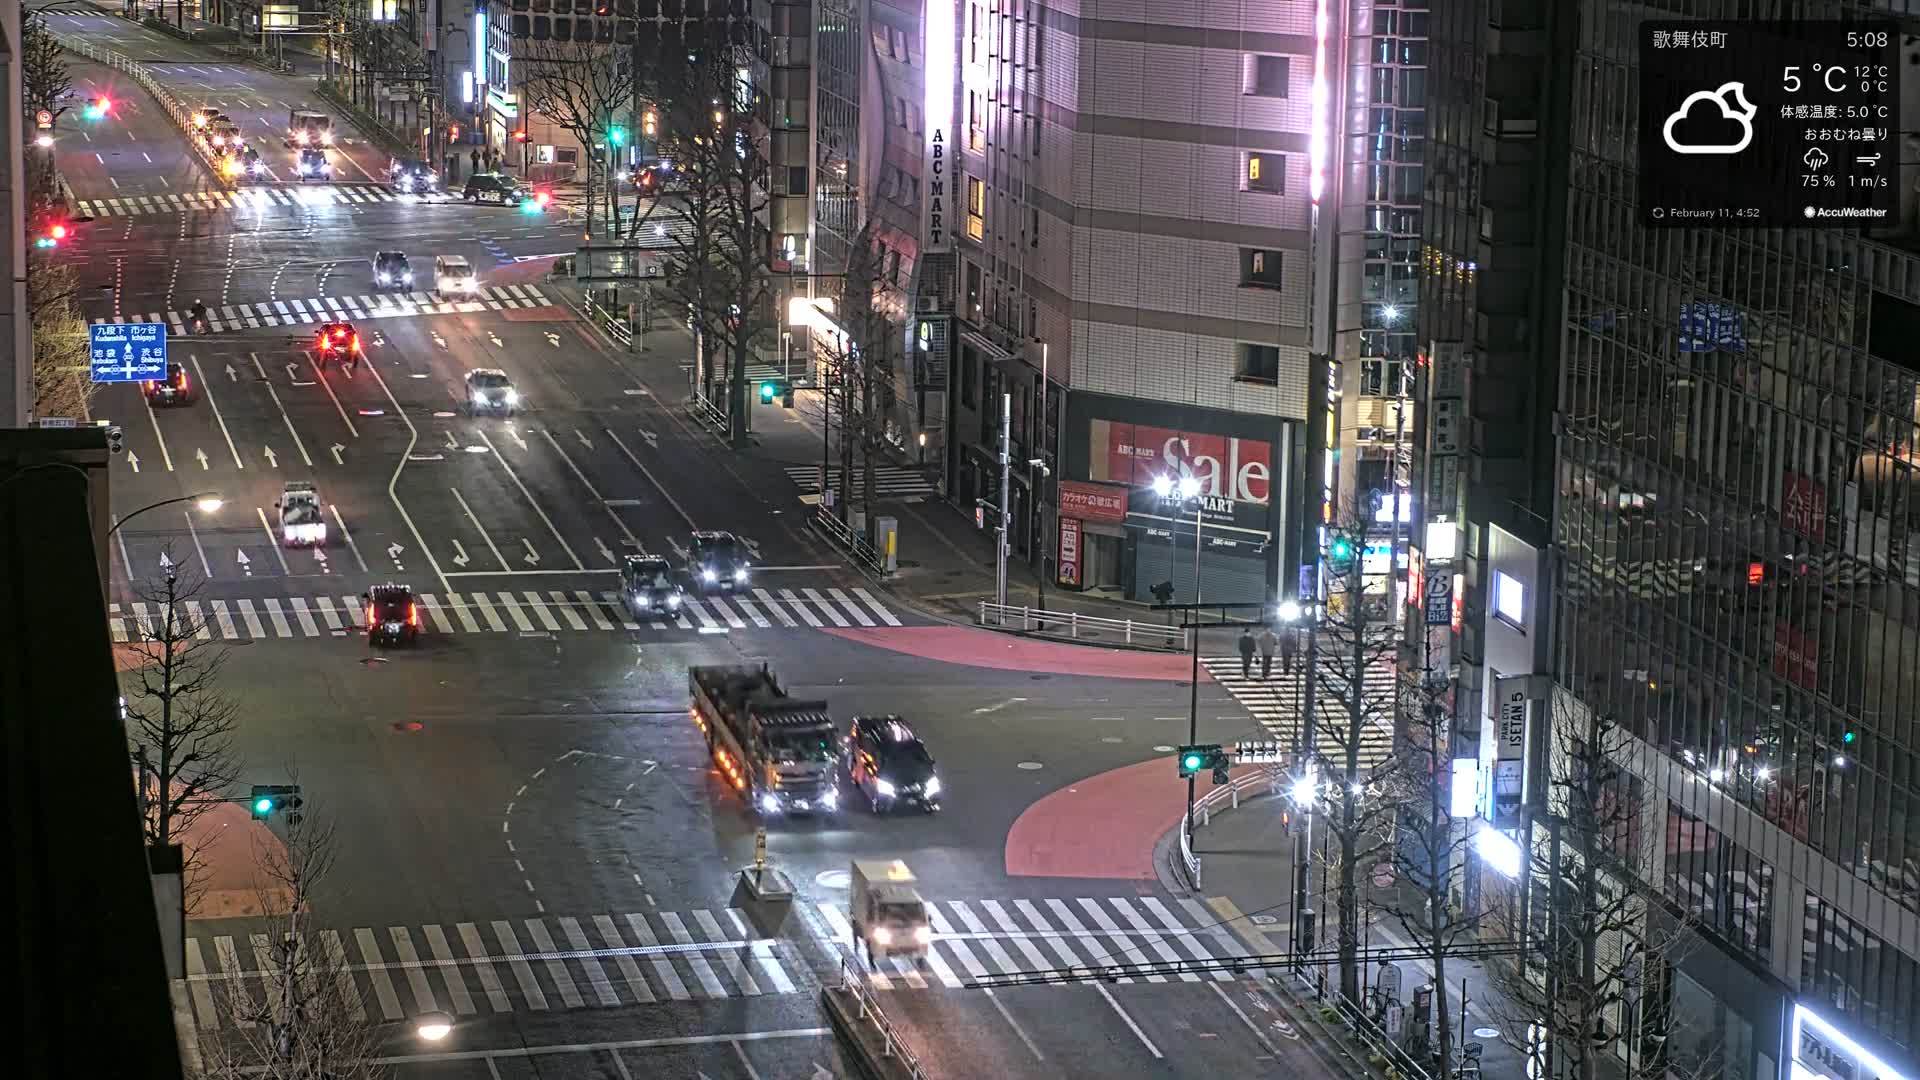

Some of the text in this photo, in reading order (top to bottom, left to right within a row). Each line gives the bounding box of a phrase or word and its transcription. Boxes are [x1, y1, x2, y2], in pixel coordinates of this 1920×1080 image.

[97, 325, 125, 335] 九段下
[1163, 437, 1270, 506] Sale
[1509, 691, 1524, 747] ISETAN 5
